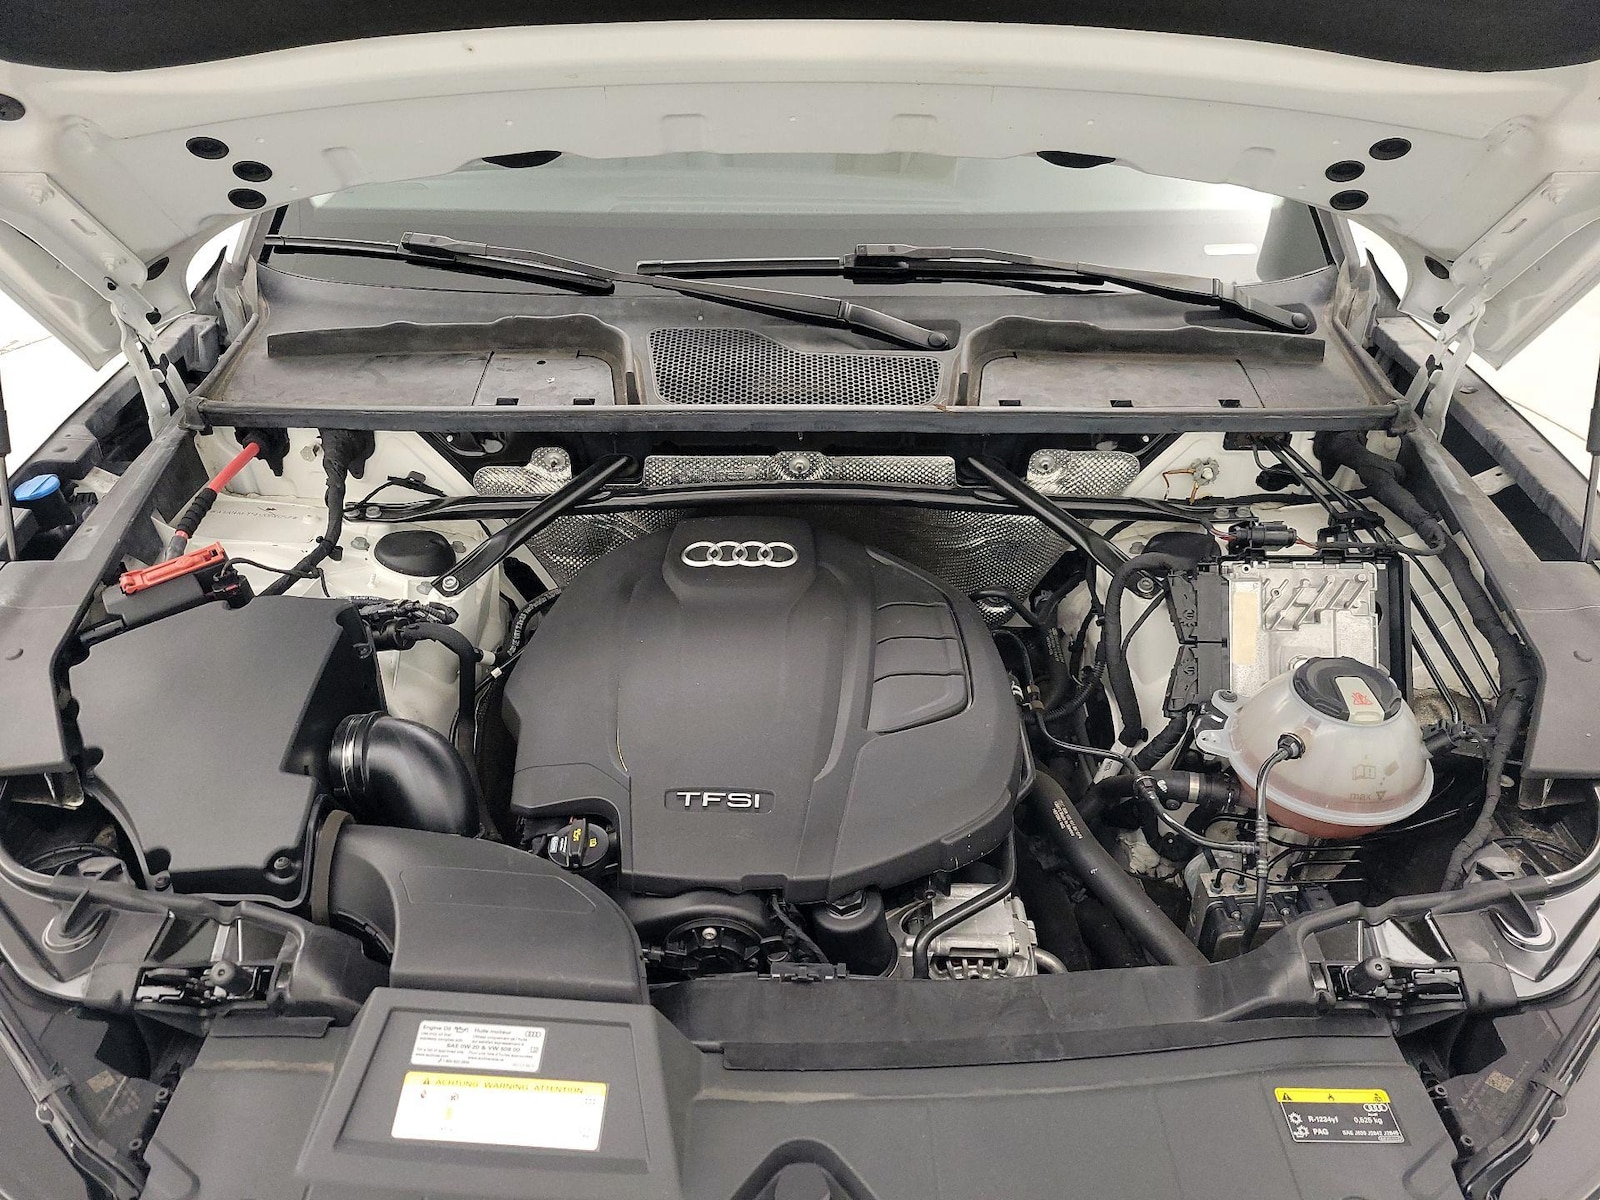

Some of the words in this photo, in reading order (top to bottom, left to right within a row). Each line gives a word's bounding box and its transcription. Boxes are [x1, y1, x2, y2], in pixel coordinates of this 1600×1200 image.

[676, 792, 760, 808] TFSI
[435, 1079, 479, 1088] ACHTUNG
[484, 1081, 529, 1091] WARNING
[533, 1084, 584, 1094] ATTENTION
[1307, 1115, 1339, 1124] R-1234yf
[1373, 1117, 1383, 1125] kg
[1312, 1128, 1329, 1136] PAG
